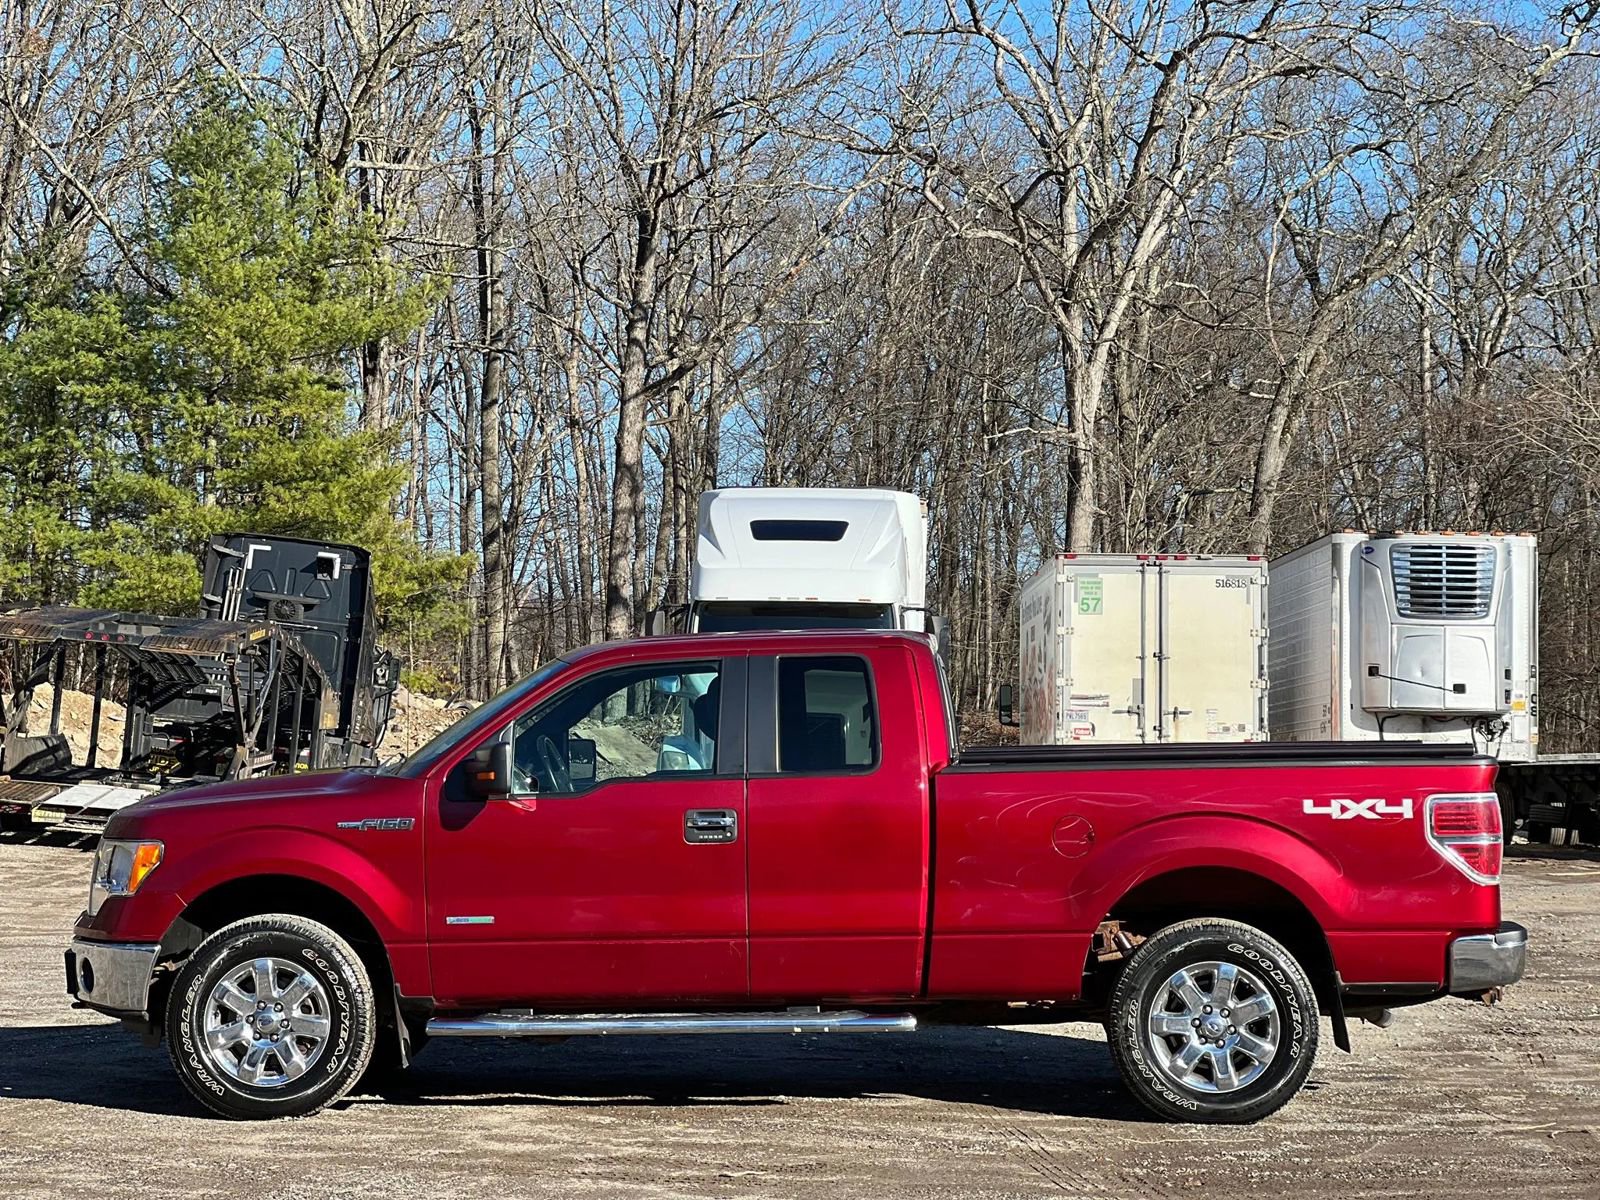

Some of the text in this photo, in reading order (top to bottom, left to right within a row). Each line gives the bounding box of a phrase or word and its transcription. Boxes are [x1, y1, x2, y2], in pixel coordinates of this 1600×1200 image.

[1080, 597, 1101, 612] 57
[1215, 579, 1247, 588] 516818
[180, 974, 224, 1096] WRANGLER
[302, 948, 350, 1073] GOODYEAR
[1127, 1000, 1199, 1110] WRANGLER
[1227, 944, 1303, 1058] GOODYEAR
